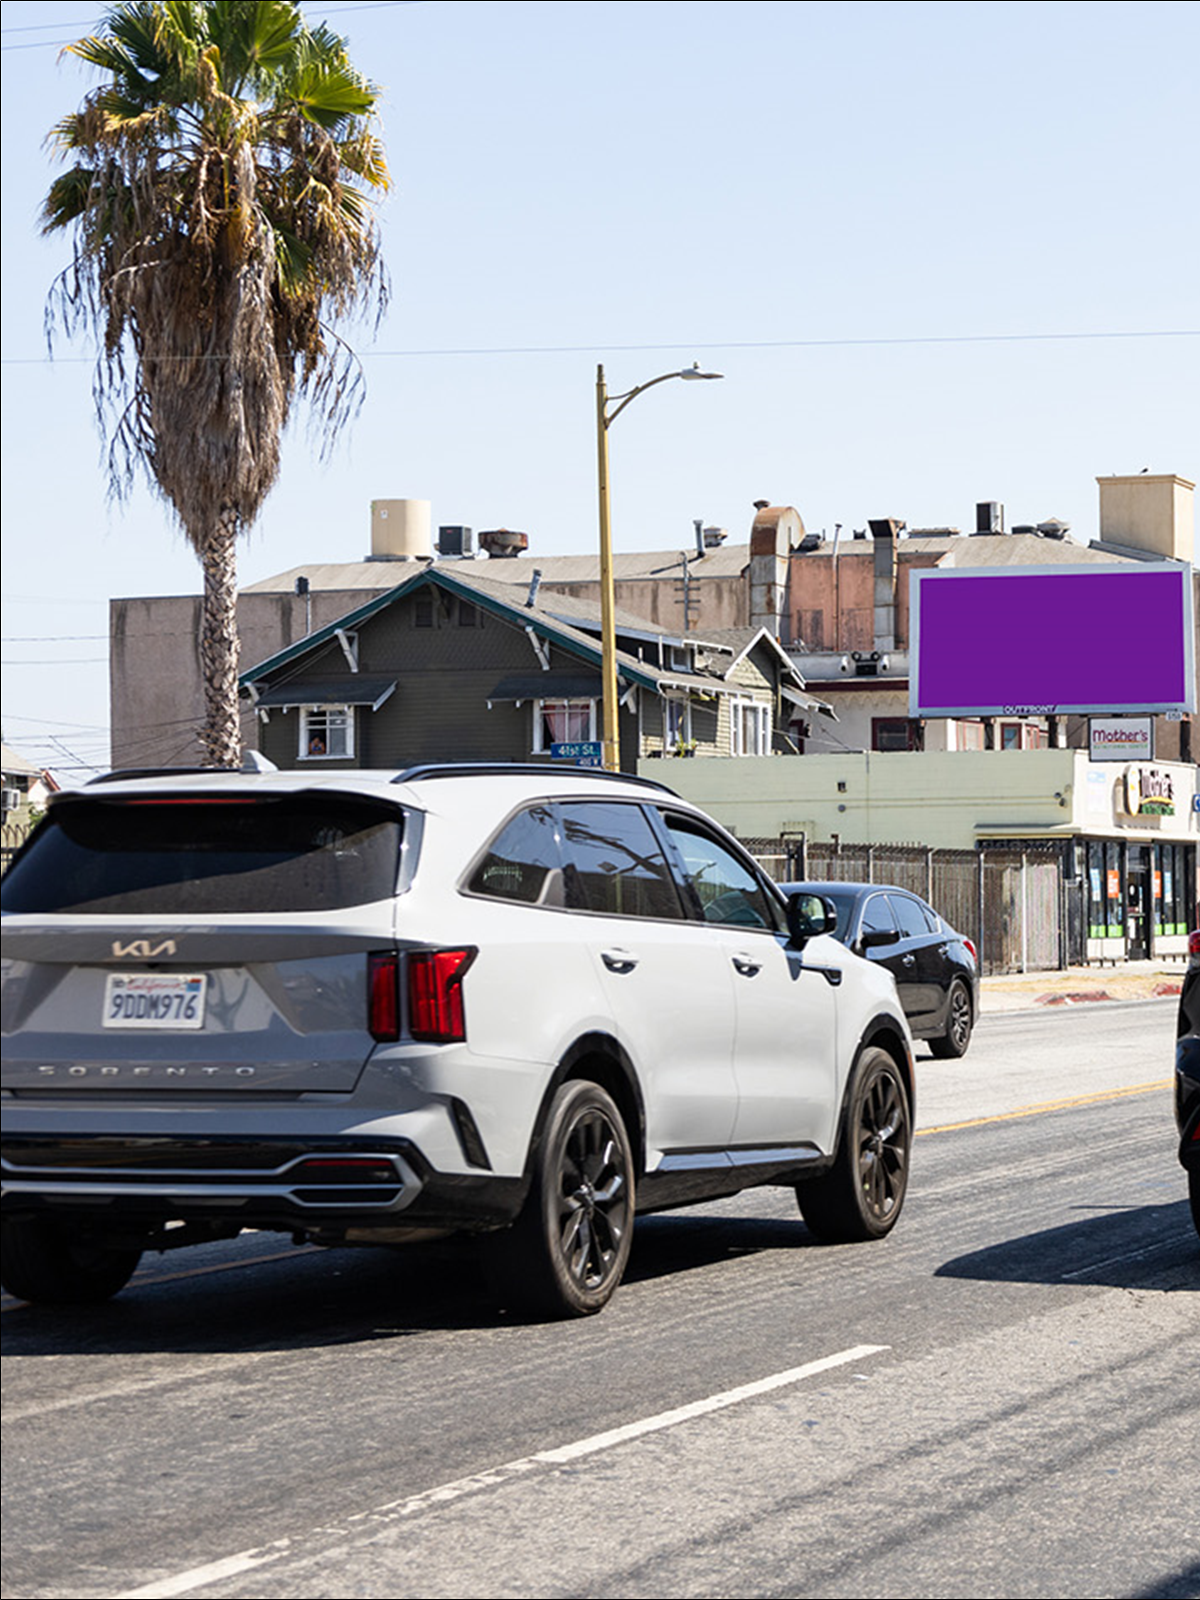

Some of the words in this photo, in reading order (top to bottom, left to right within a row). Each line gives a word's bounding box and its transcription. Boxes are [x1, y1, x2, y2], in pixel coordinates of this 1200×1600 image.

[1003, 704, 1057, 714] OUTFRONT
[1093, 730, 1148, 742] Mother's
[110, 994, 199, 1020] 9DDM976
[38, 1066, 254, 1076] SORENTO
